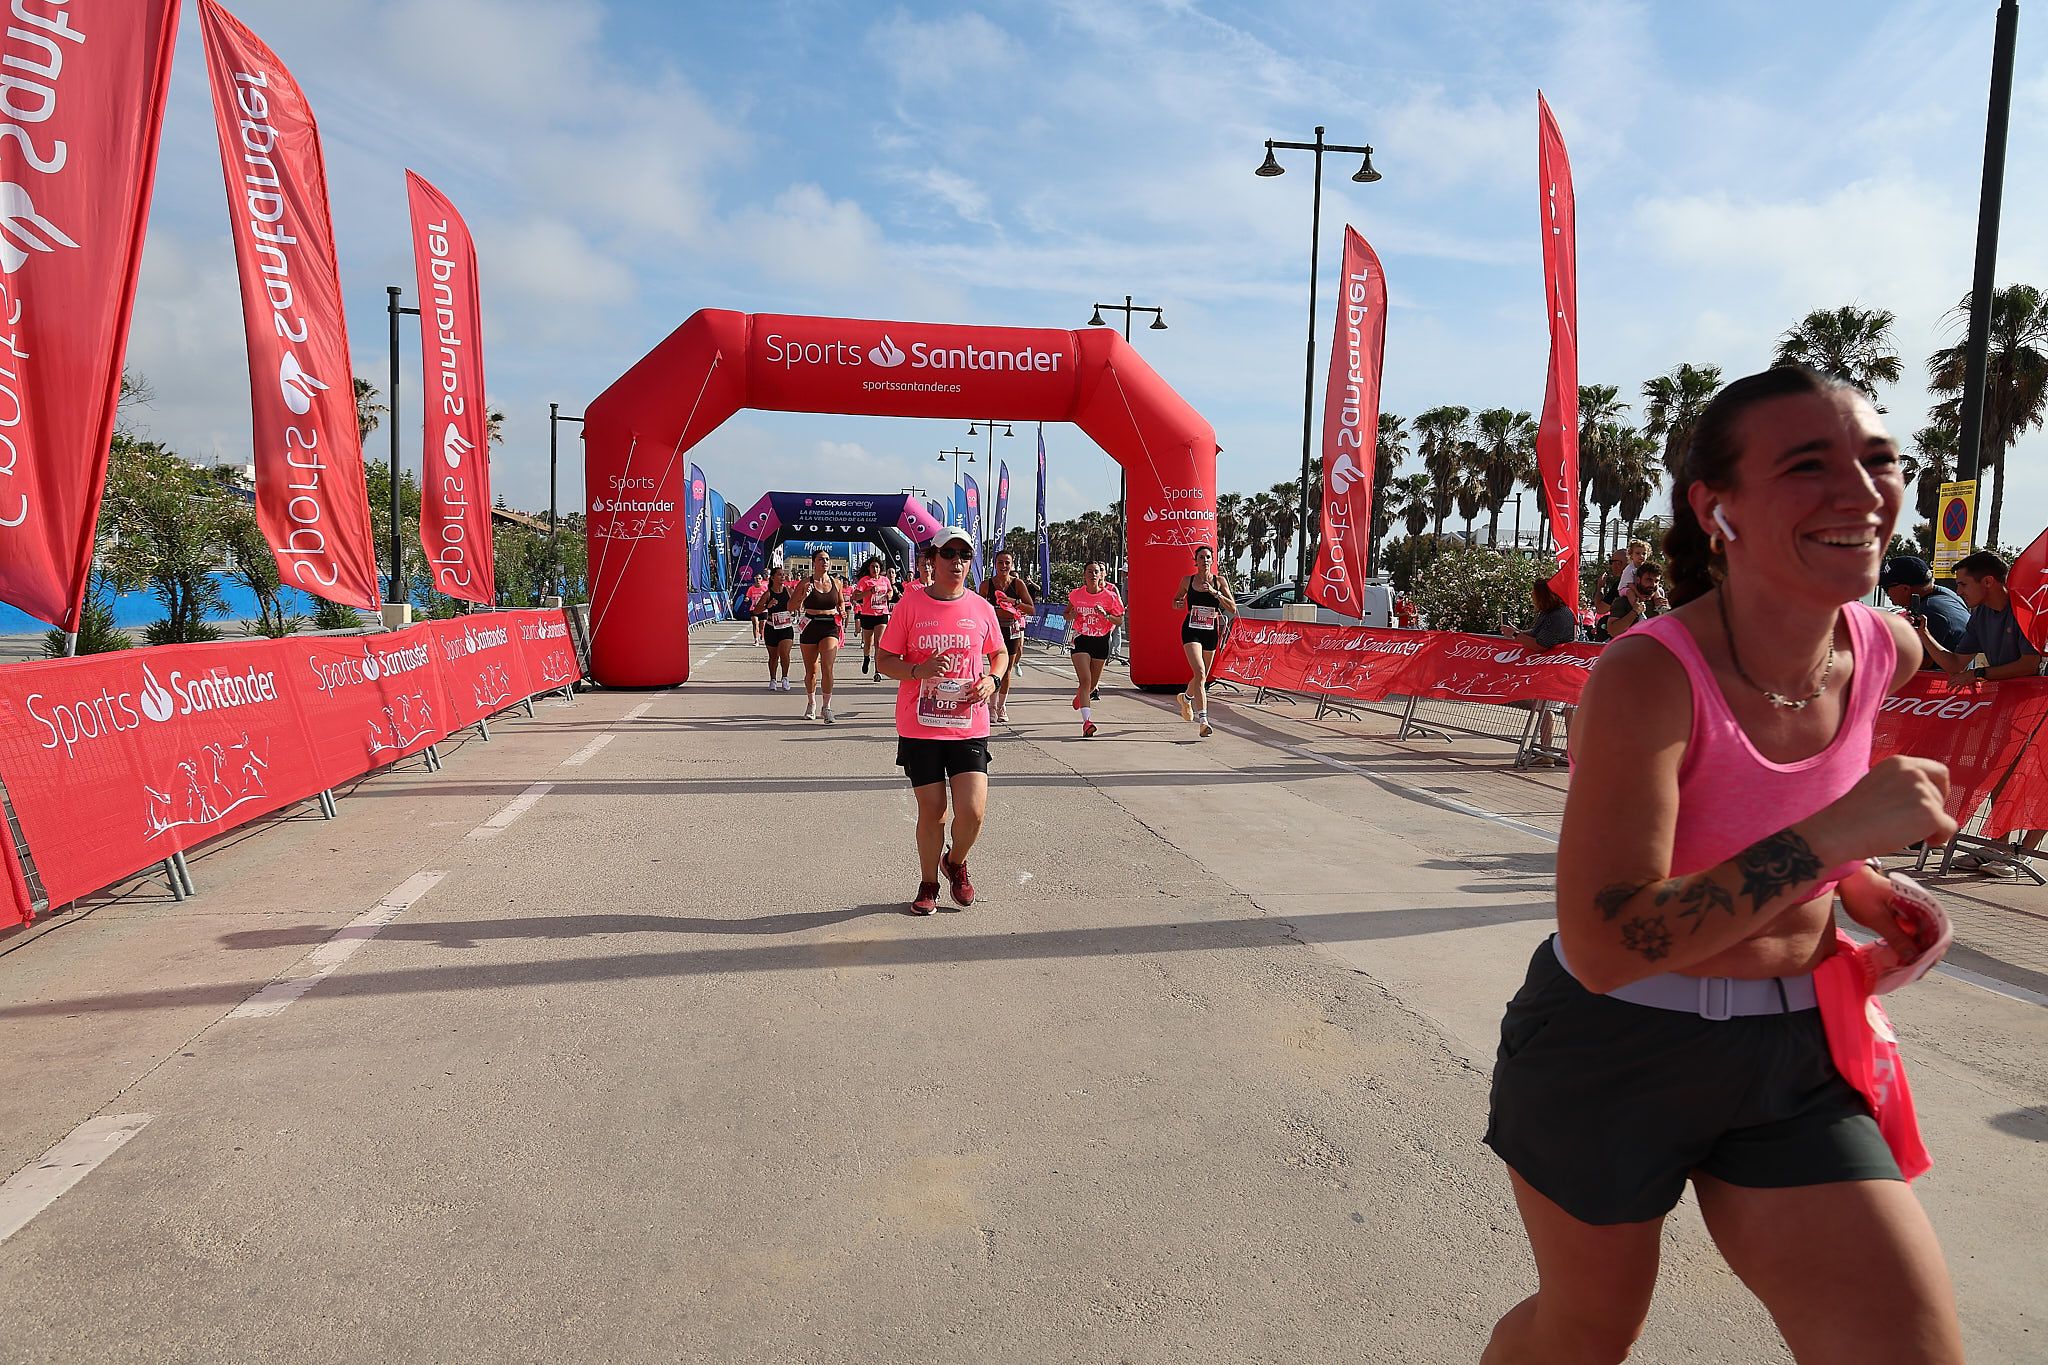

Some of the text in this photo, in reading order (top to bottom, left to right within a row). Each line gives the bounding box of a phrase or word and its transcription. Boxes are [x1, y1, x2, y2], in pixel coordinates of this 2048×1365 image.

[766, 333, 1063, 372] Sports Santander
[862, 380, 961, 393] sportssantander.es
[609, 475, 655, 491] Sports
[1163, 486, 1203, 501] Sports
[606, 499, 675, 512] Santander
[815, 499, 874, 510] octopus energy
[1160, 508, 1215, 521] Santander
[792, 524, 866, 533] VOLVO
[916, 620, 939, 628] OYSHO
[440, 624, 508, 666] Sports Santander
[1313, 634, 1425, 656] Sports Santander
[1444, 640, 1499, 659] Sports
[309, 641, 430, 698] Sports Santander
[26, 665, 279, 759] Sports Santander
[936, 700, 957, 710] 016
